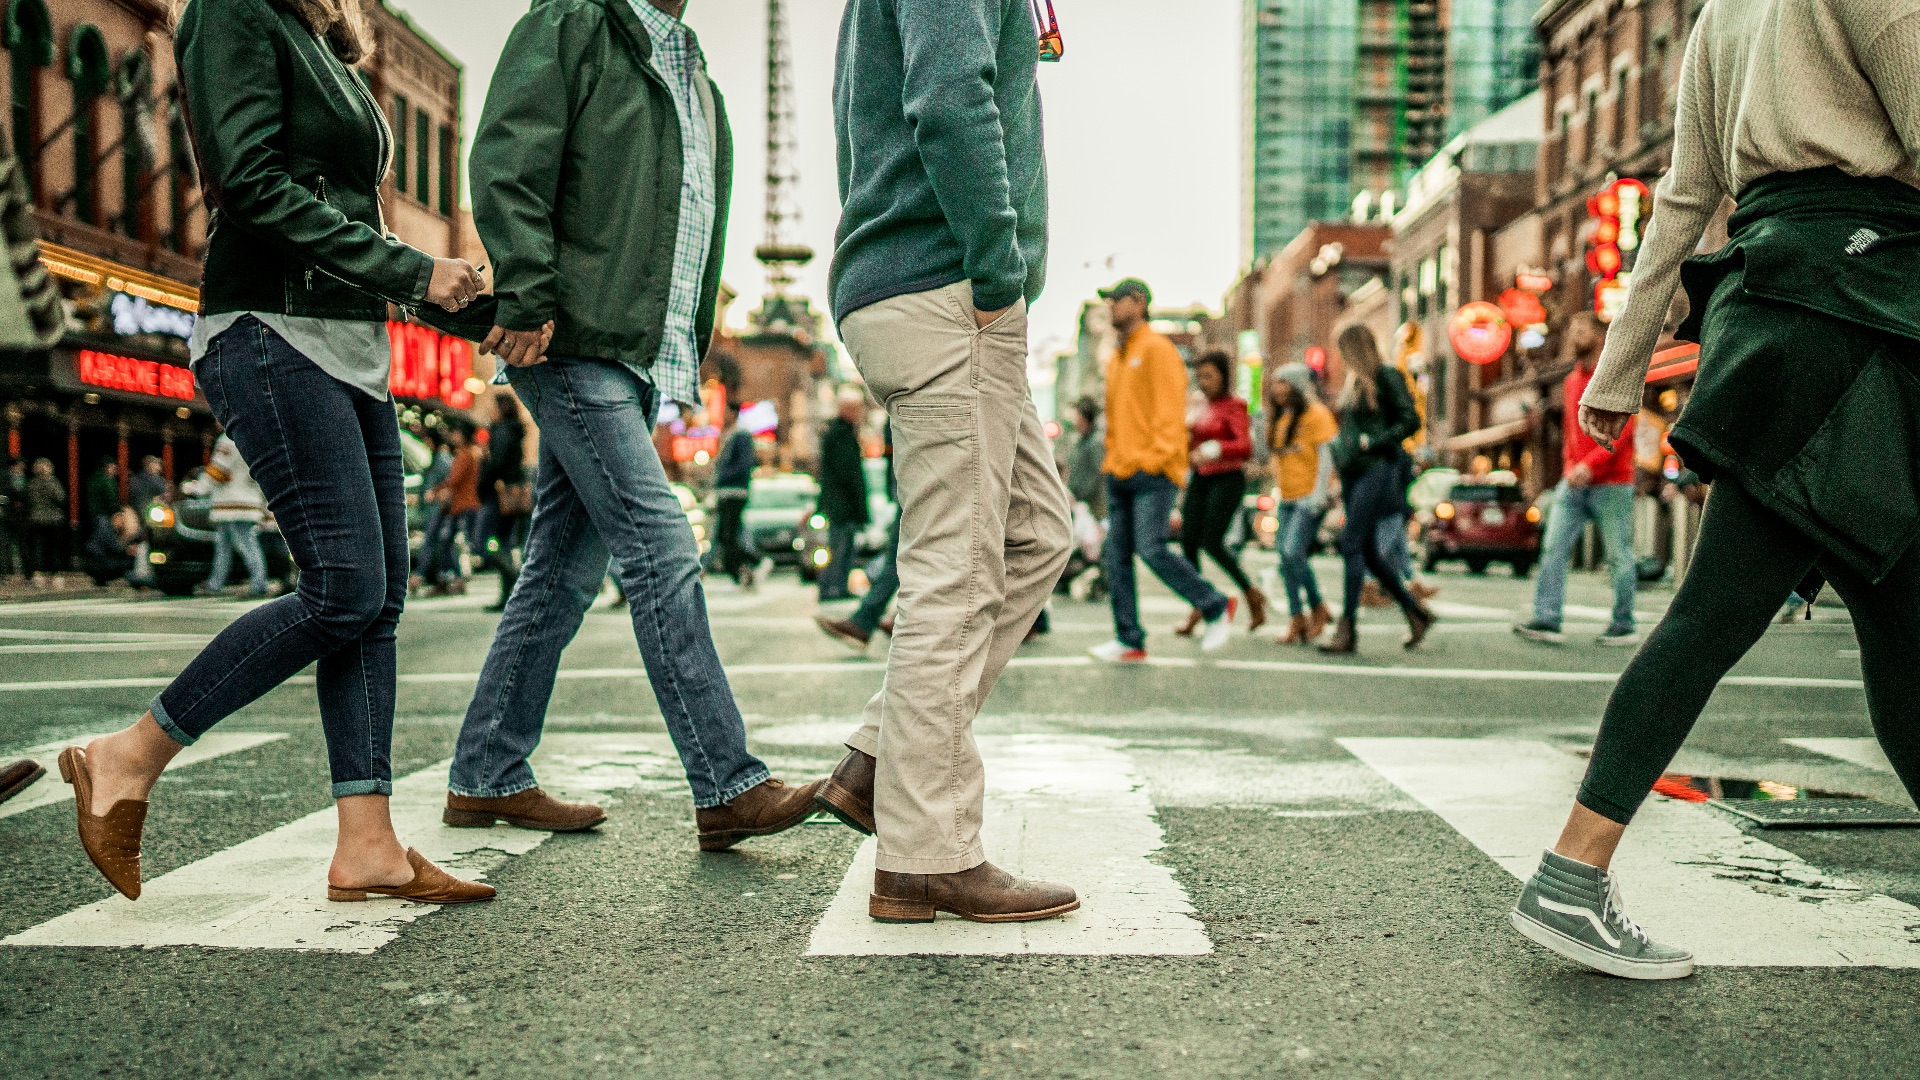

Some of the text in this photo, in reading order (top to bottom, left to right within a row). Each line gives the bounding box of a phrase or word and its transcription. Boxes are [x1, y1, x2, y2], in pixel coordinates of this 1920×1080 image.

[1845, 232, 1868, 255] NORTH
[1849, 229, 1864, 242] THE
[1855, 236, 1872, 254] FACE
